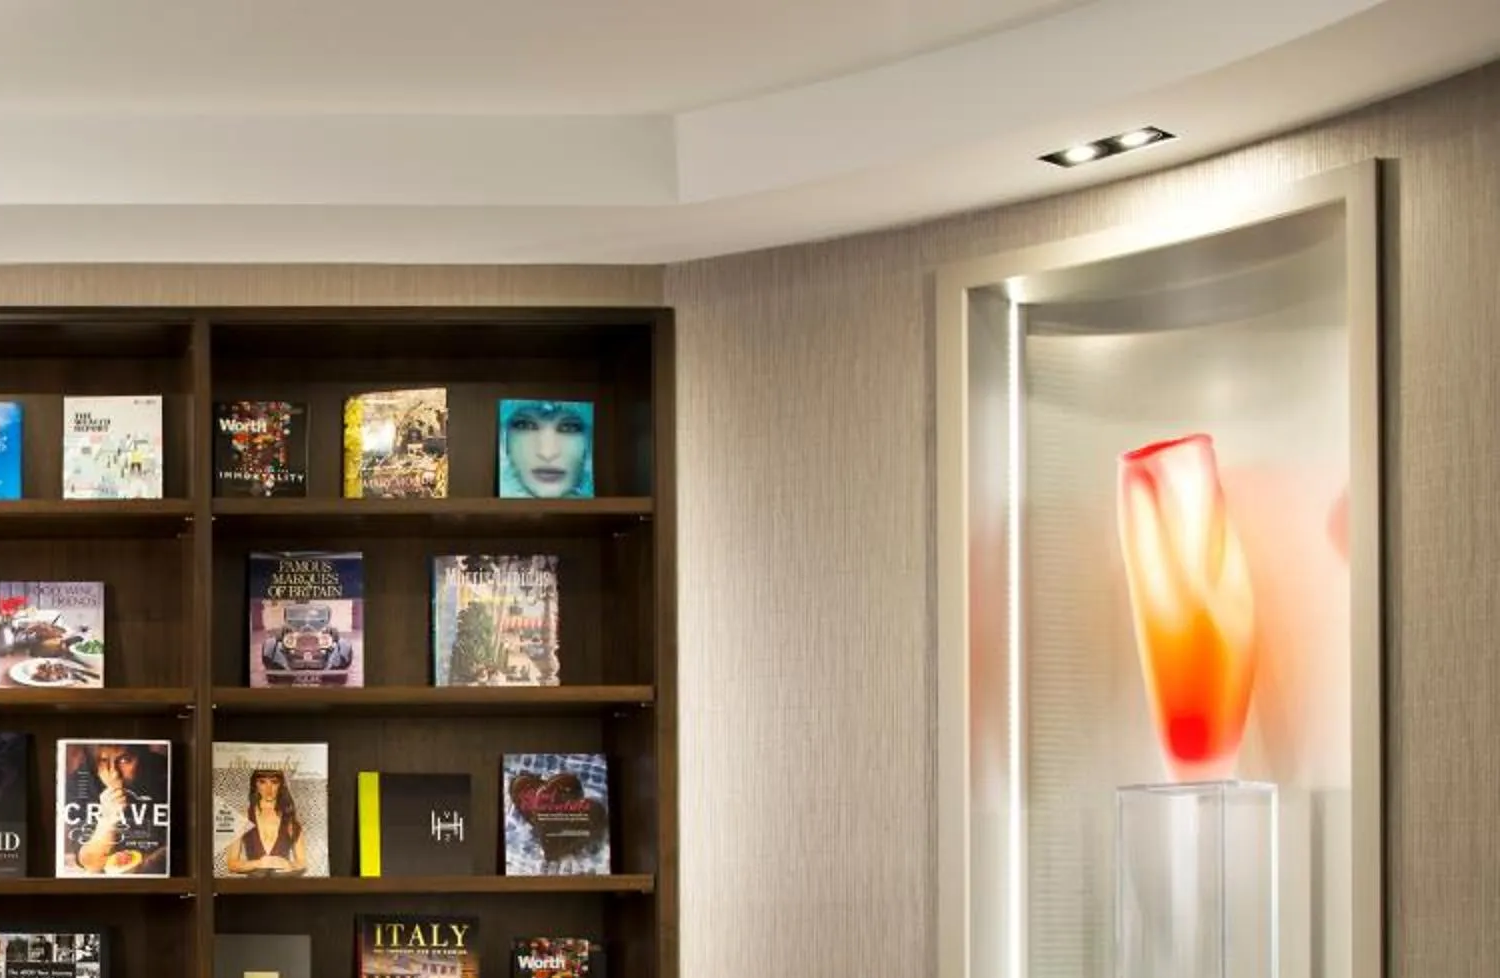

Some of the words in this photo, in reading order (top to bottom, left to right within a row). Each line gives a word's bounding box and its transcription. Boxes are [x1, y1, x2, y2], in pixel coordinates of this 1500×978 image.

[219, 418, 267, 432] Worth
[219, 471, 305, 482] IMMORTALITY
[280, 560, 333, 573] FAMOUS
[267, 585, 285, 597] OF
[288, 585, 343, 597] BRITAIN
[374, 923, 469, 947] ITALY
[517, 955, 566, 969] Worth
